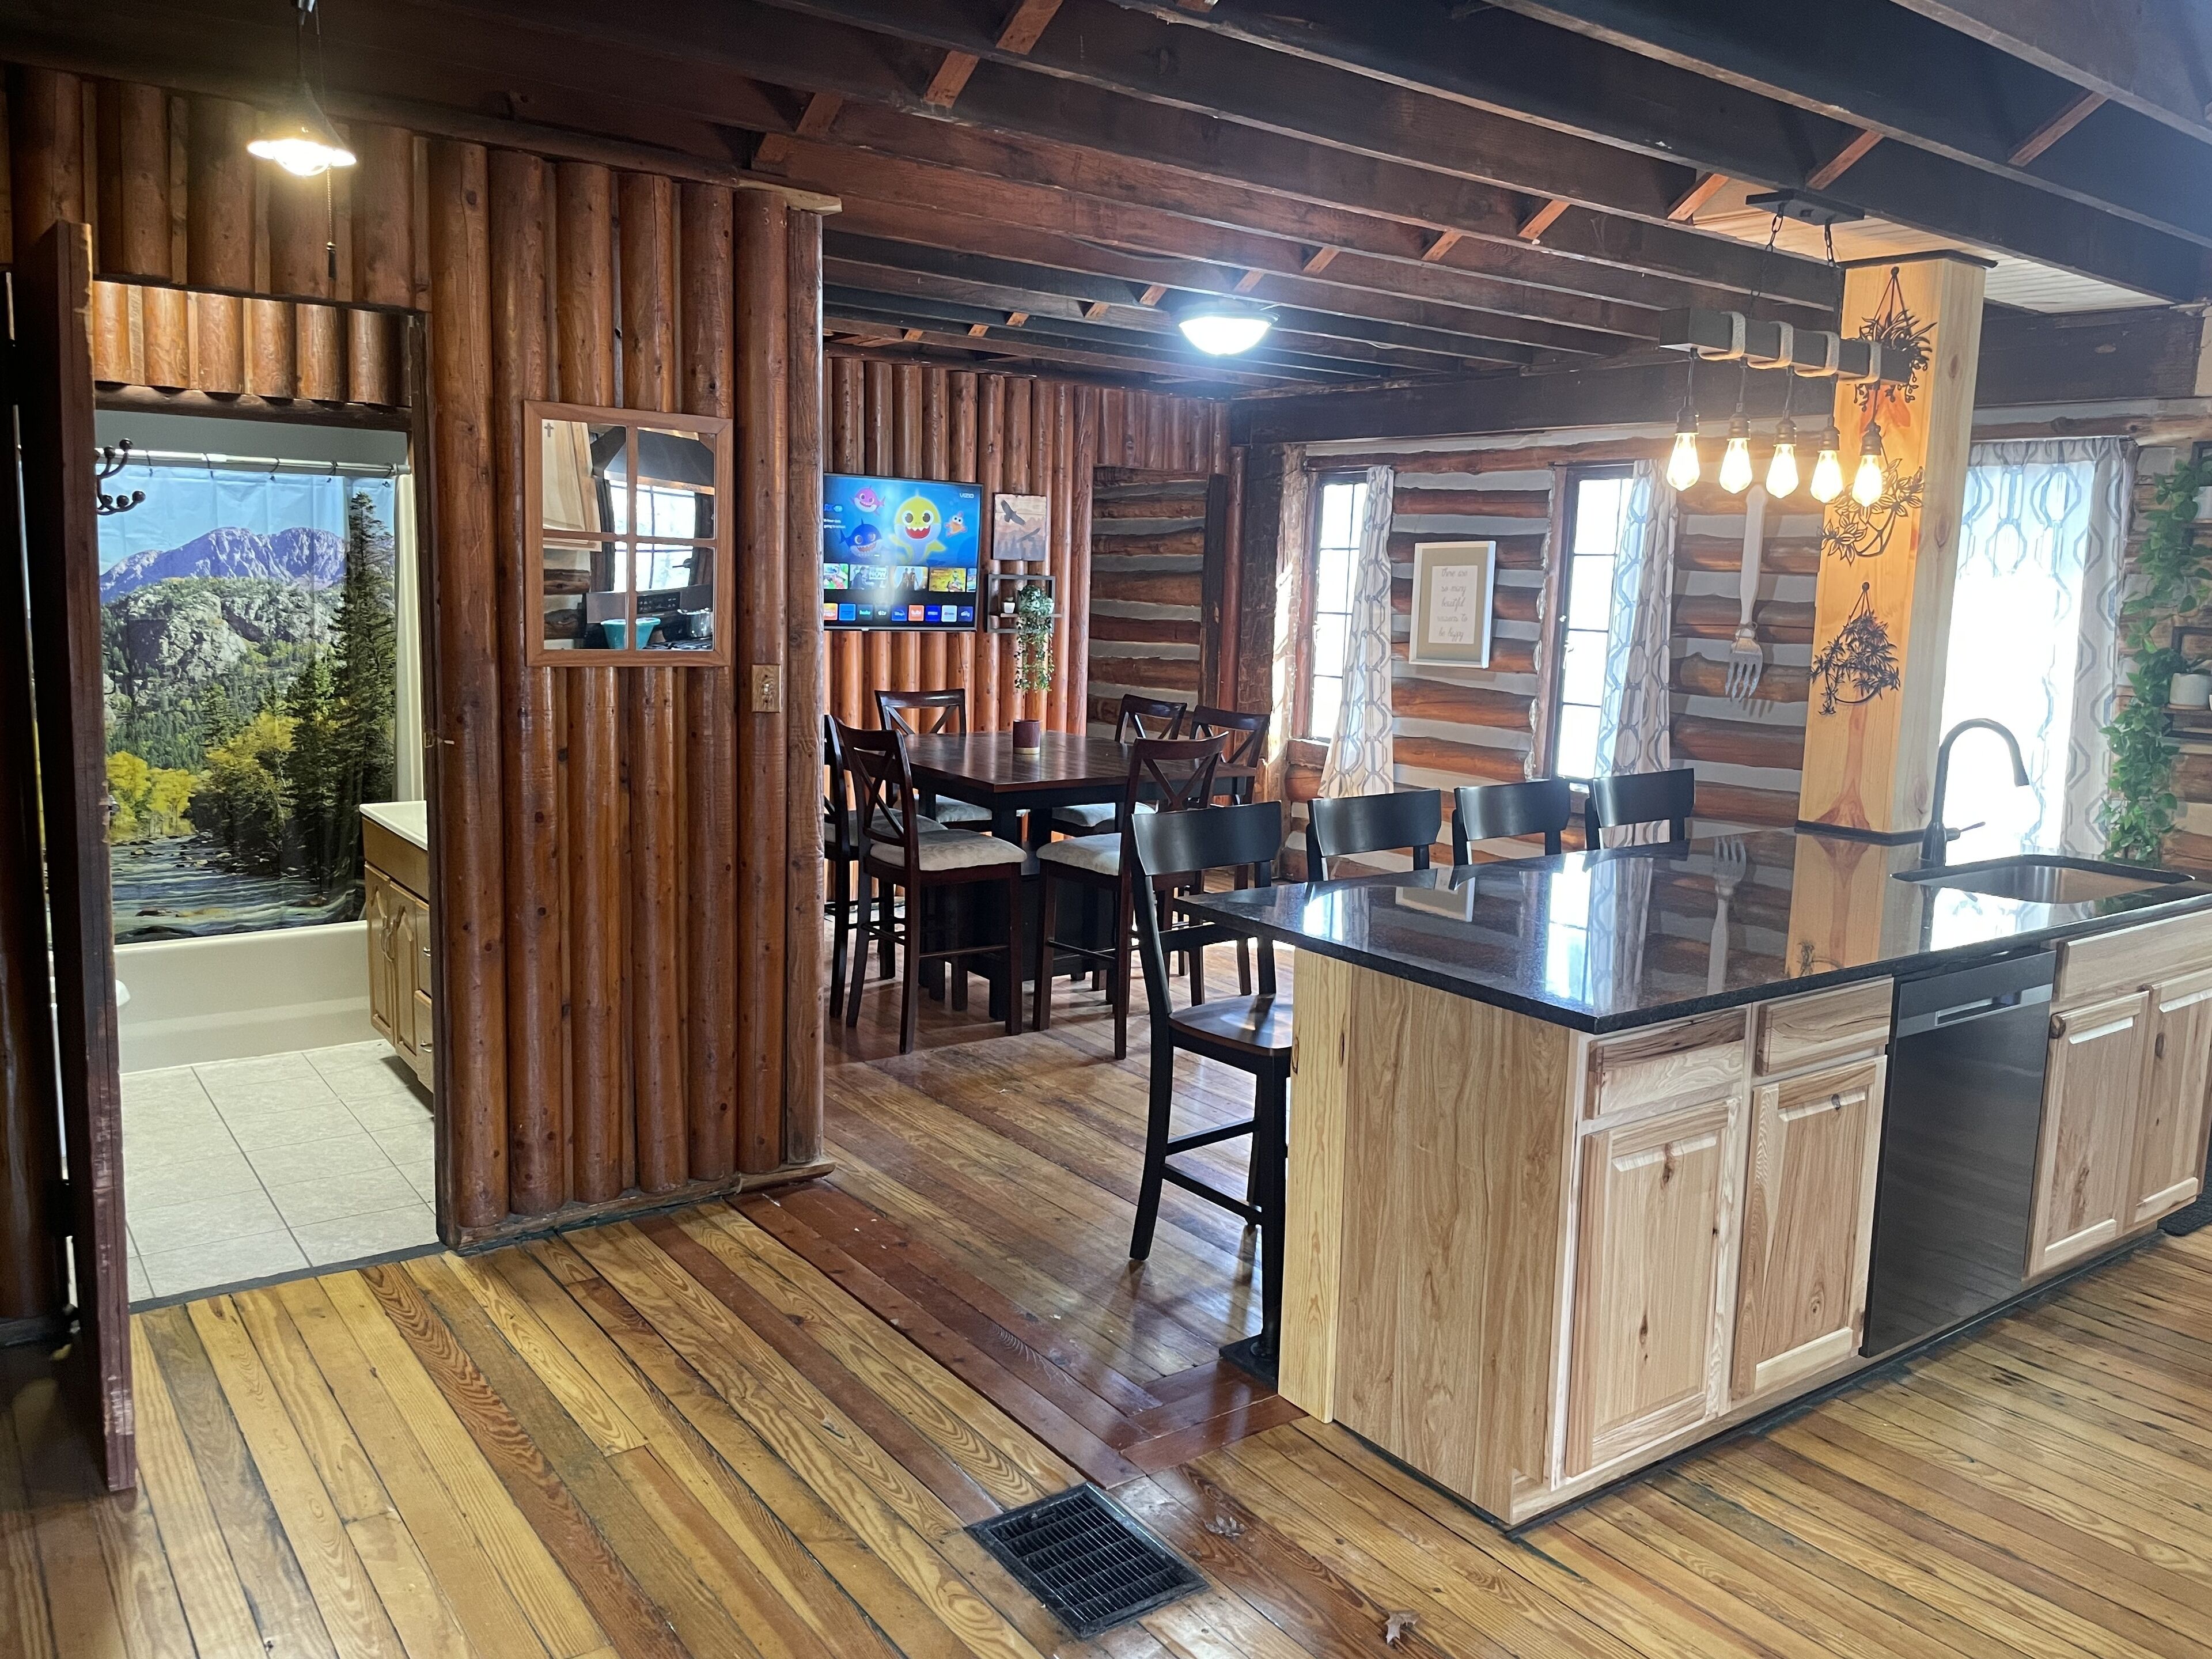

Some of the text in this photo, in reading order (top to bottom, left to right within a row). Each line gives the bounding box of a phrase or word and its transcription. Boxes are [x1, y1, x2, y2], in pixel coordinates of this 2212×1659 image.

[1441, 567, 1456, 577] There
[1438, 627, 1464, 642] be happy
